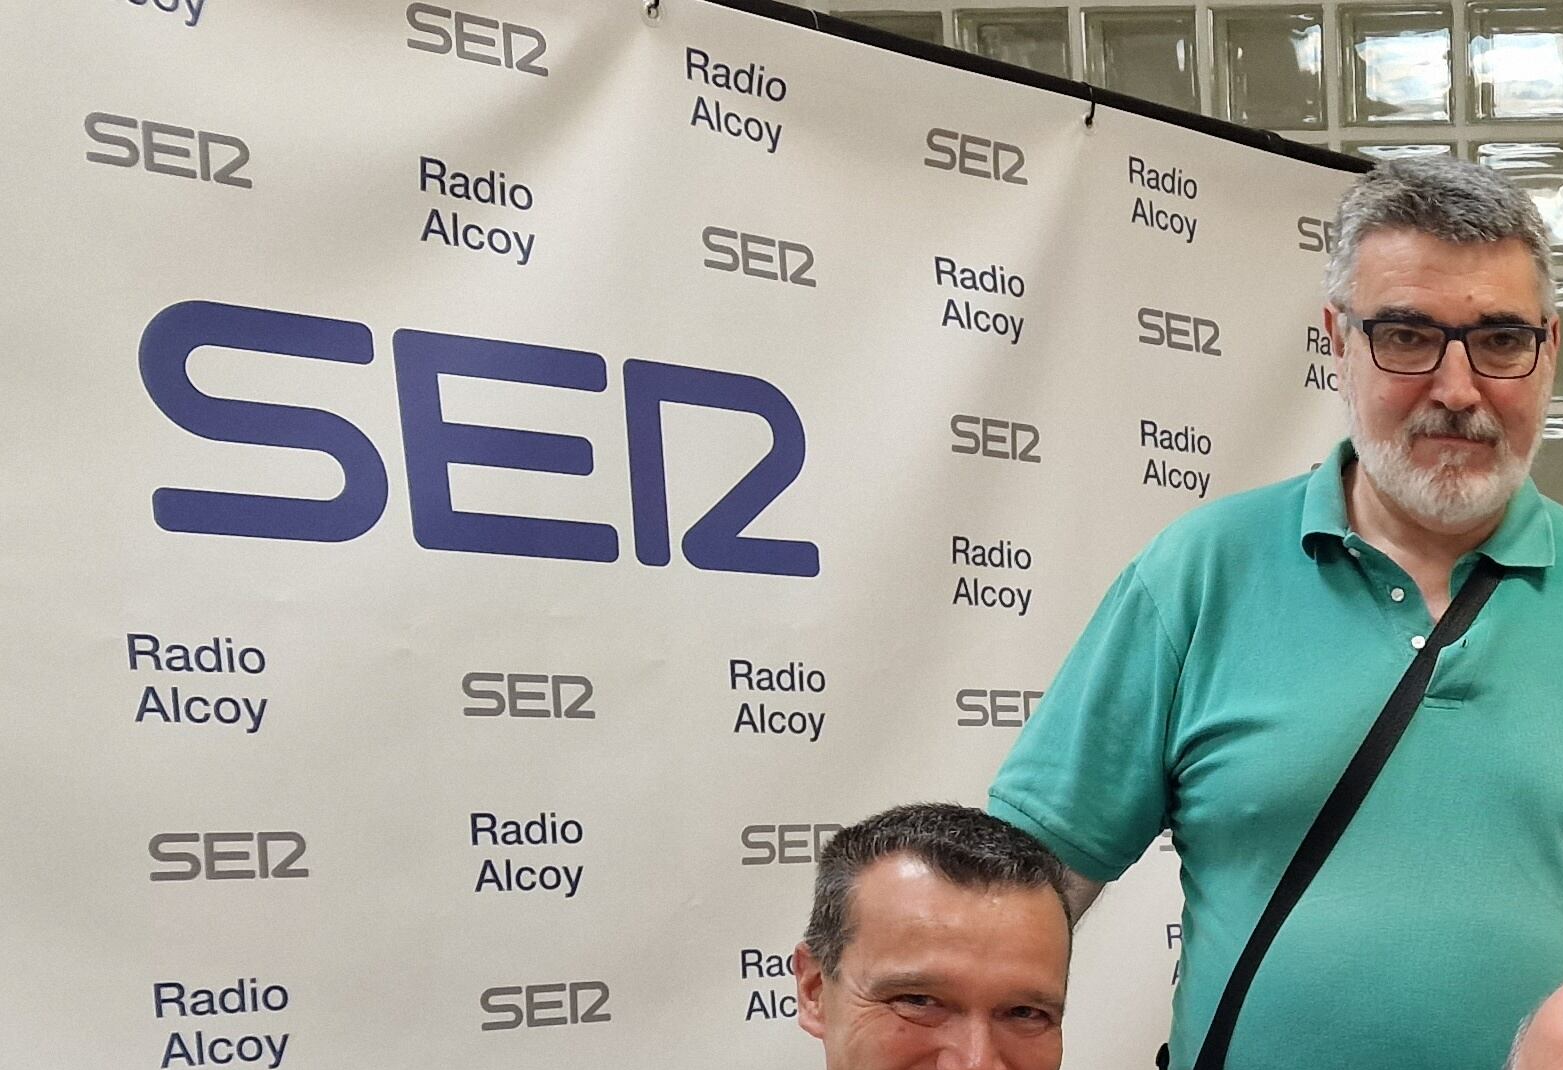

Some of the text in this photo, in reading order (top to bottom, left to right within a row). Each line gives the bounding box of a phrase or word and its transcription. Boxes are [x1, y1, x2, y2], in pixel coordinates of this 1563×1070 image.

[406, 2, 548, 77] SER
[686, 46, 787, 102] Radio
[690, 96, 784, 154] Alcoy
[85, 112, 252, 189] SER
[924, 128, 1027, 185] SER
[421, 157, 532, 210] Radio
[1129, 156, 1197, 199] Radio
[420, 208, 535, 265] Alcoy
[1131, 198, 1197, 243] Alcoy
[702, 226, 816, 287] SER
[935, 256, 1024, 297] Radio
[942, 299, 1024, 344] Alcoy
[1138, 308, 1221, 356] SER
[1304, 363, 1338, 391] Alc
[139, 300, 820, 577] SER
[951, 415, 1041, 463] SER
[1141, 420, 1211, 455] Radio
[1144, 459, 1210, 498] Alcoy
[953, 536, 1031, 569] Radio
[953, 577, 1031, 616] Alcoy
[127, 634, 265, 674] Radio
[730, 660, 825, 692] Radio
[136, 687, 267, 733] Alcoy
[462, 672, 595, 719] SER
[734, 703, 825, 742] Alcoy
[471, 813, 582, 845] Radio
[148, 832, 309, 881] SER
[475, 859, 583, 897] Alcoy
[154, 978, 288, 1017] Radio
[480, 981, 611, 1031] SER
[745, 989, 798, 1021] Alc
[162, 1031, 289, 1069] Alcoy
